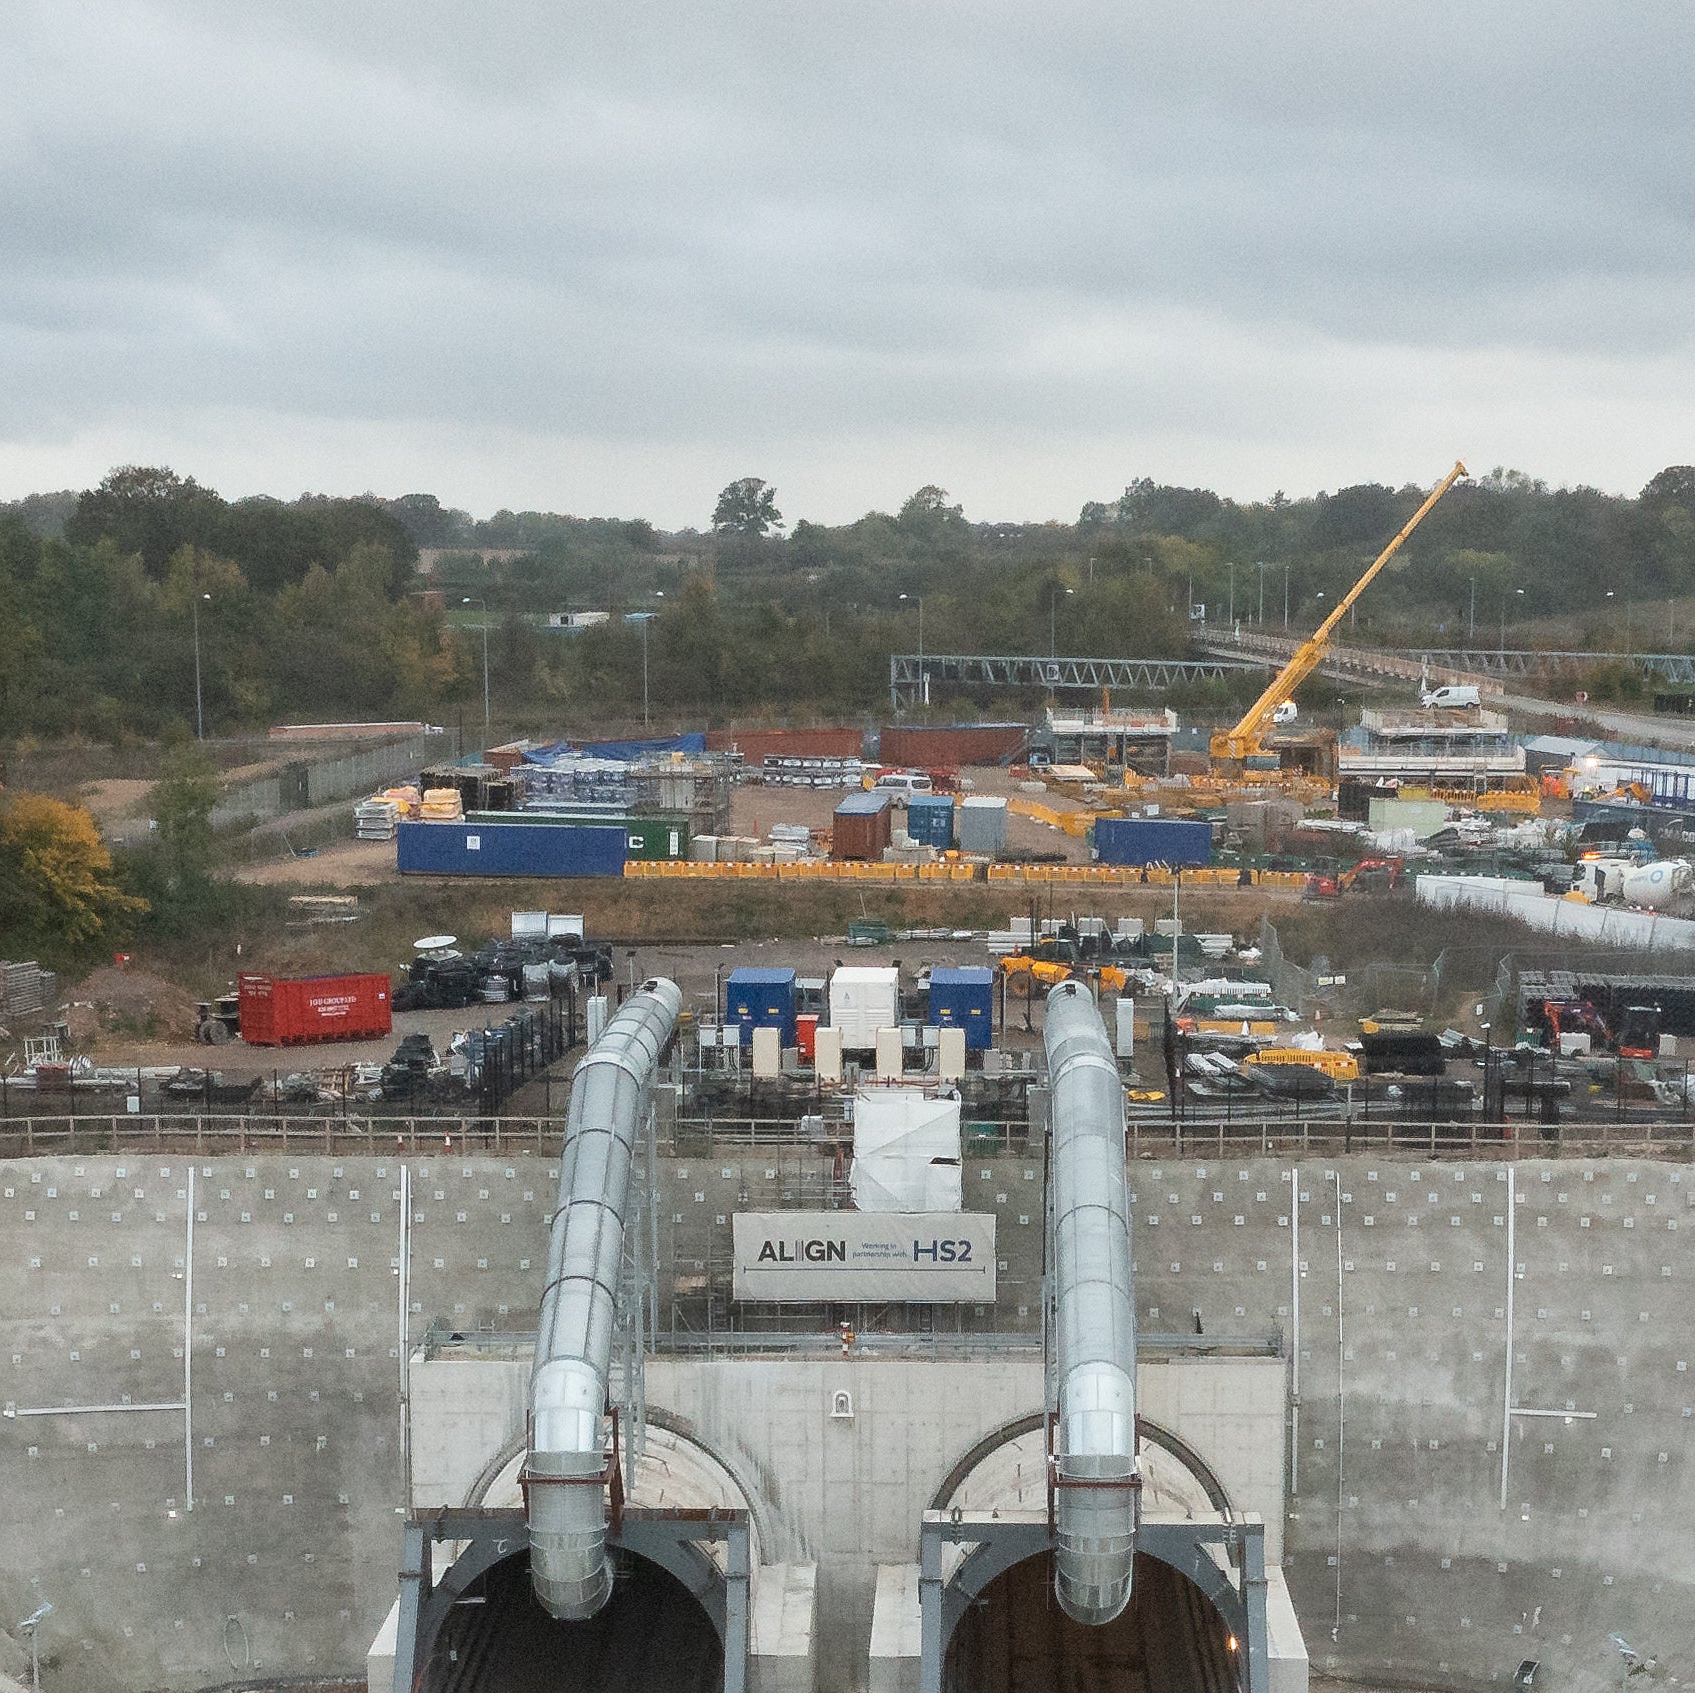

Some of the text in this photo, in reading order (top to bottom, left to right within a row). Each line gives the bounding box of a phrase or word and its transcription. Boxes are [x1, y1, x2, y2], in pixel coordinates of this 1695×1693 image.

[757, 1240, 846, 1262] ALIGN
[861, 1242, 885, 1251] Working
[913, 1240, 972, 1262] HS2
[852, 1250, 908, 1259] partnership with
